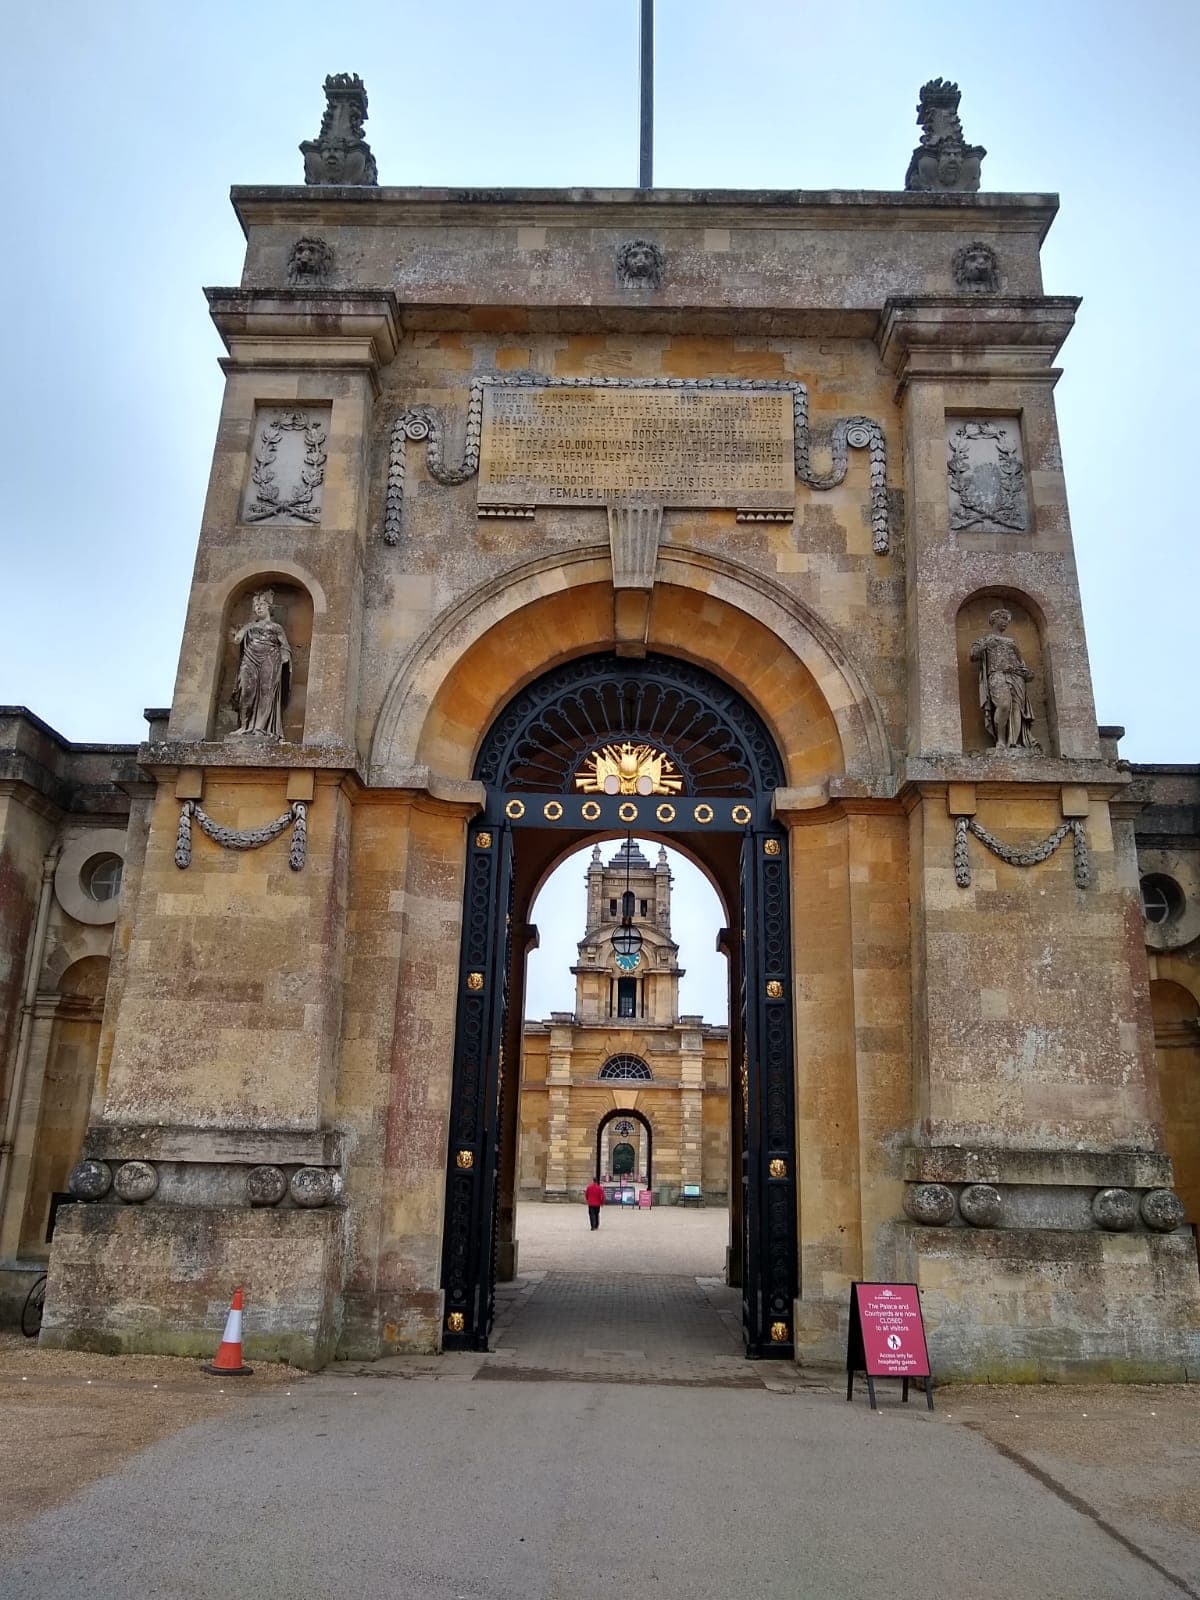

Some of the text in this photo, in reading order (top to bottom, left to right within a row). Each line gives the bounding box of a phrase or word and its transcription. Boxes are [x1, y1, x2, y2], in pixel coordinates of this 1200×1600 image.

[752, 397, 784, 406] HOUSE
[544, 405, 564, 415] FOR
[594, 440, 646, 450] TOWARDS
[562, 452, 582, 461] HER
[584, 452, 636, 462] MAJESTY
[676, 477, 694, 487] HIS
[550, 488, 594, 498] FEMALE
